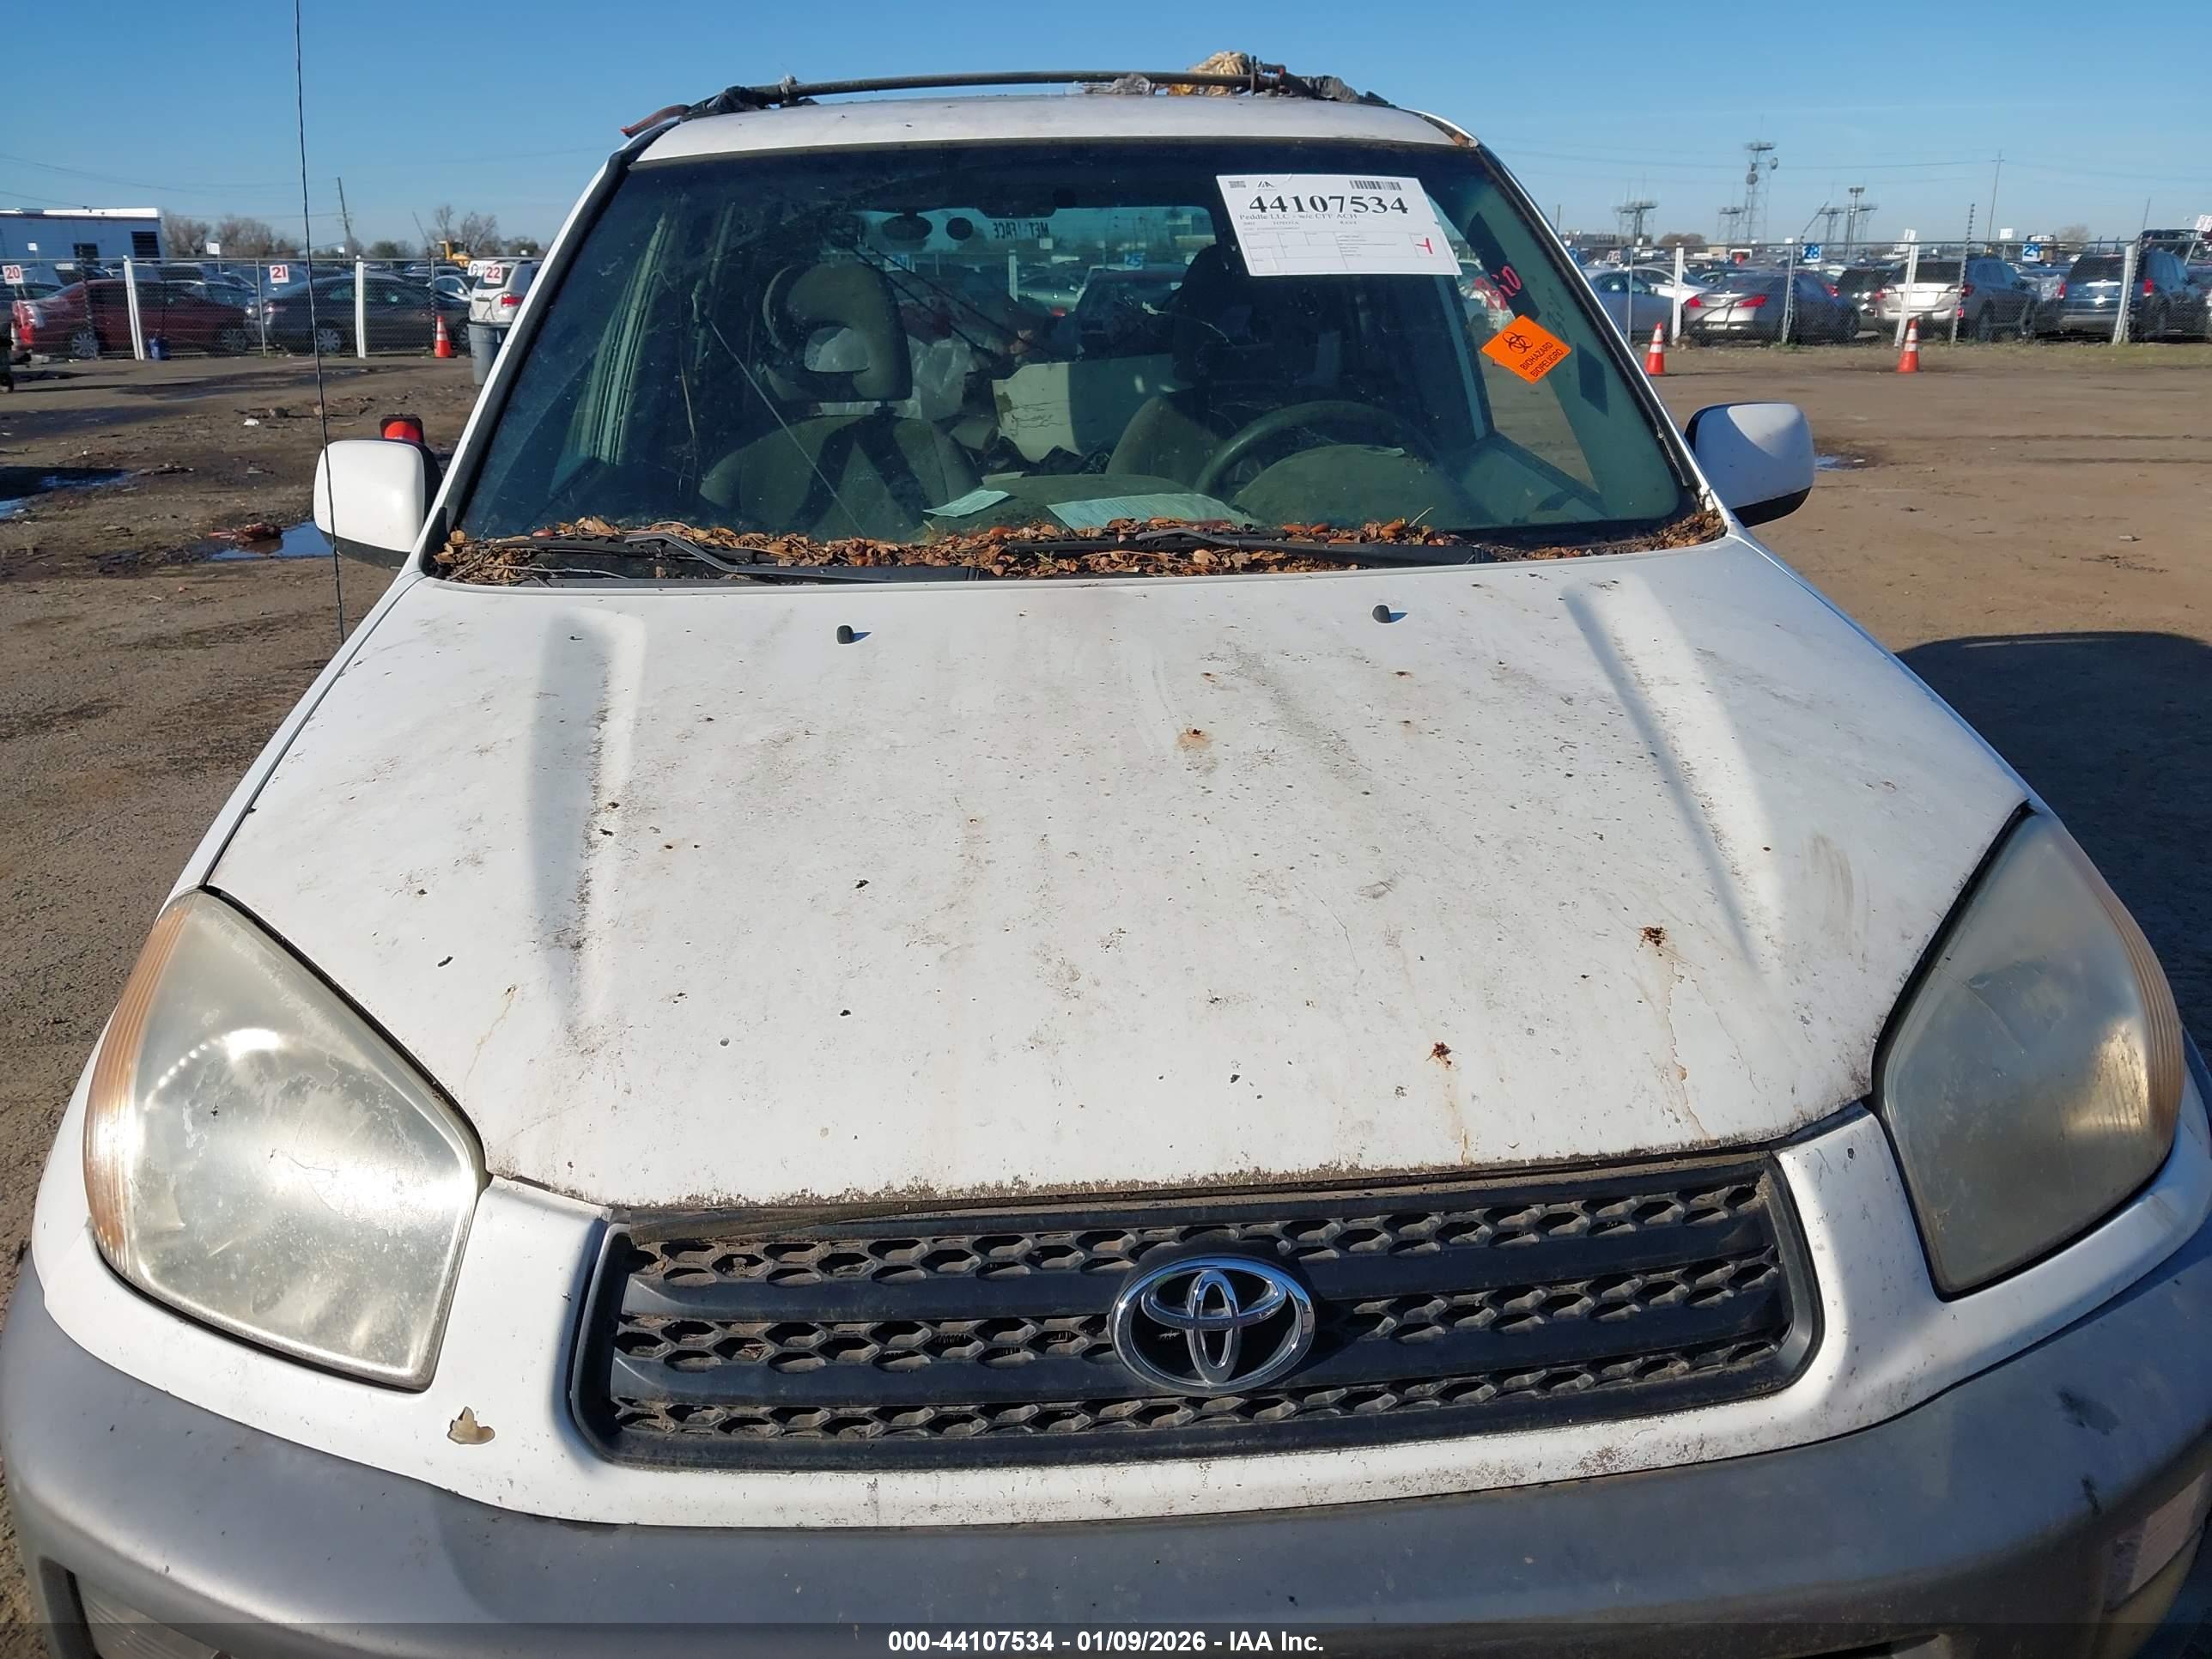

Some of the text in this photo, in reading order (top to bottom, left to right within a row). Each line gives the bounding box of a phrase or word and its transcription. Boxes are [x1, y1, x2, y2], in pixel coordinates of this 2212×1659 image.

[1249, 195, 1409, 215] 44107534
[1803, 242, 1820, 258] 28
[2023, 243, 2041, 259] 29
[5, 267, 21, 280] 20
[271, 266, 287, 279] 21
[486, 266, 501, 279] 22
[1520, 342, 1553, 370] BIOHAZARD
[1530, 349, 1564, 378] BIOPELIGRO
